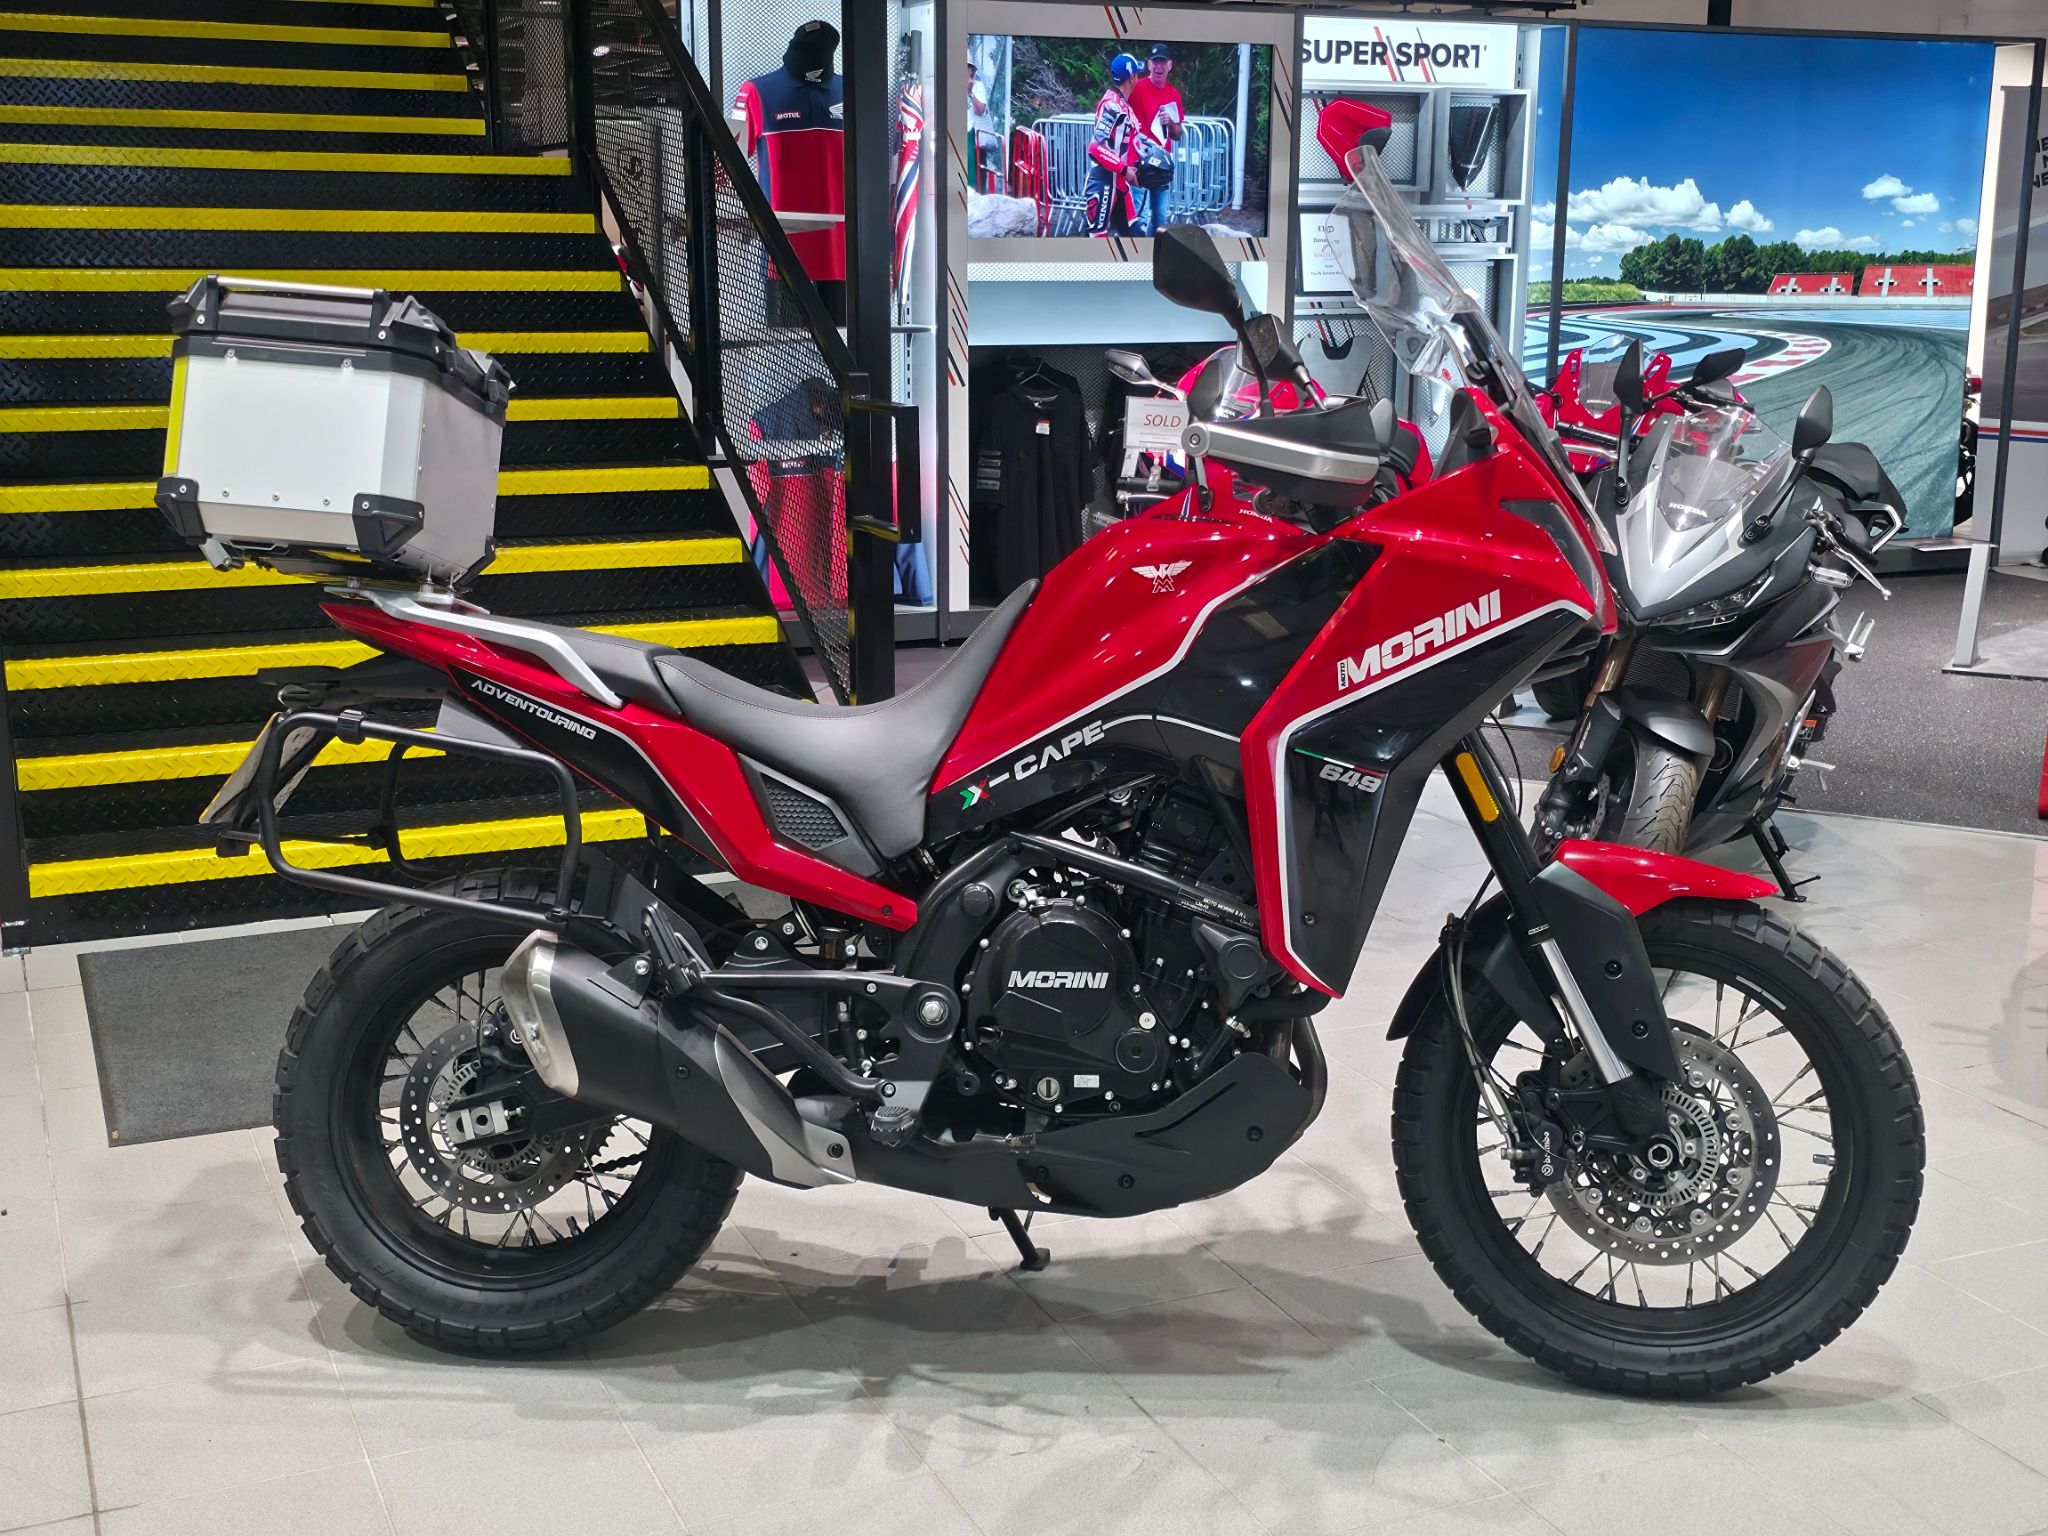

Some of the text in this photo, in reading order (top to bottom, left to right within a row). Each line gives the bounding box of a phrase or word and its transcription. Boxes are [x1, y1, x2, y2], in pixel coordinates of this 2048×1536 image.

[1302, 38, 1388, 66] SUPER
[776, 112, 801, 120] MOTUL
[1098, 185, 1111, 230] HONDA
[1143, 414, 1181, 428] SOLD
[1668, 502, 1708, 518] HONDA
[1347, 588, 1501, 685] MORINI
[471, 679, 597, 740] ADVENTOURING
[959, 719, 1105, 811] X-CAPE
[1319, 763, 1382, 793] 649
[1008, 970, 1109, 989] MORINI
